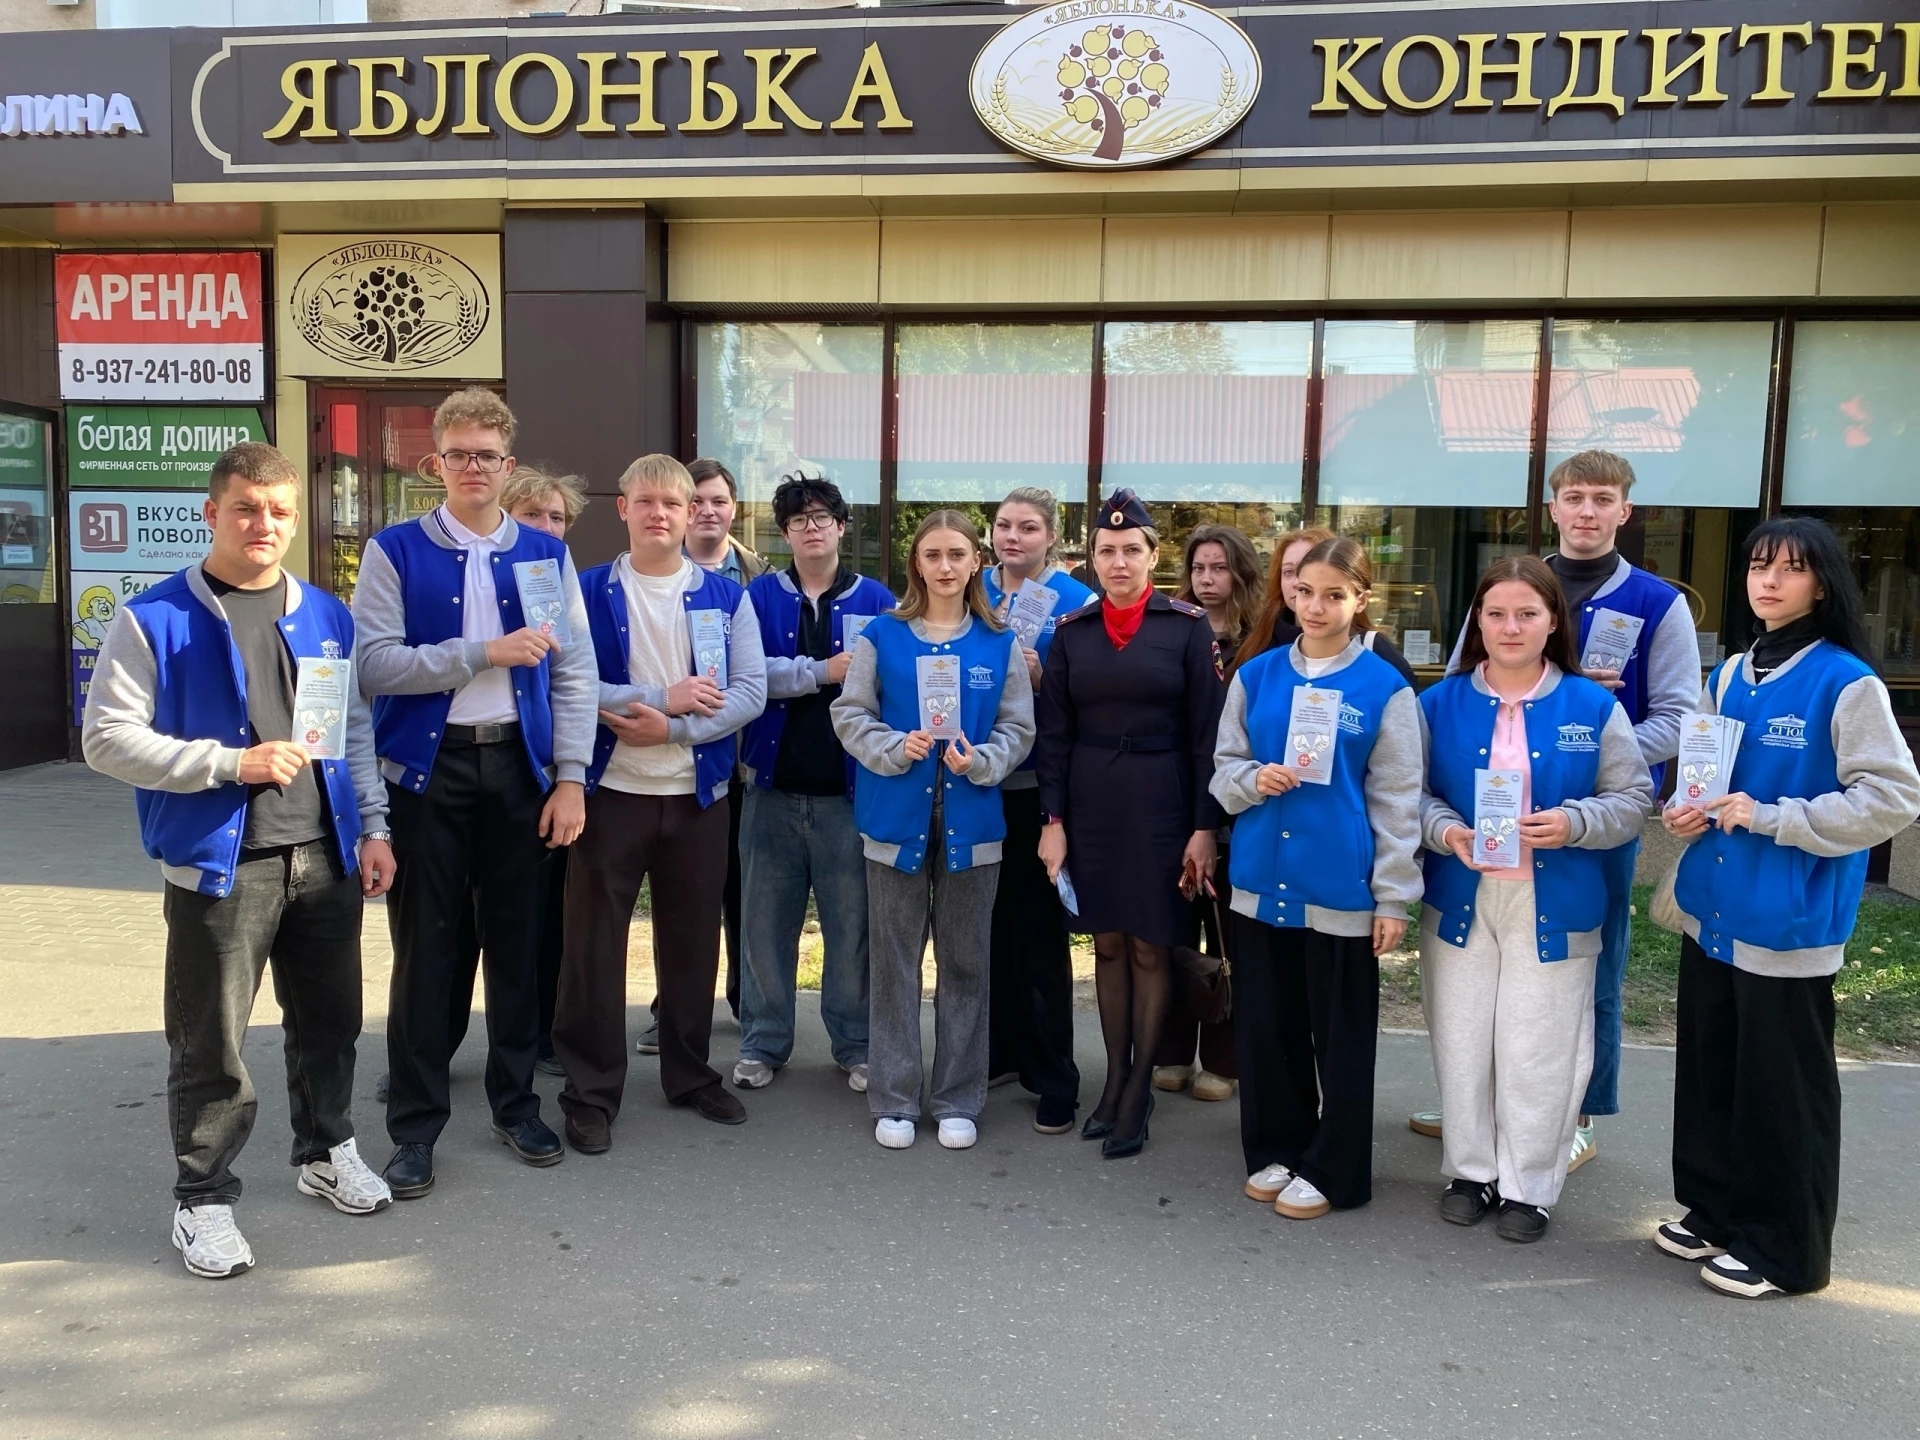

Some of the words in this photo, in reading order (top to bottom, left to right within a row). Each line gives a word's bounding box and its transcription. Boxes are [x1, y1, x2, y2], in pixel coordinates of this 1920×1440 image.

[263, 42, 914, 139] ЯБЛОНЬКА
[0, 93, 143, 136] ЛИНА
[70, 273, 248, 329] АРЕНДА
[72, 358, 252, 384] 8-937-241-80-08
[77, 415, 151, 452] белая
[79, 460, 134, 471] ФИРМЕННАЯ
[136, 461, 159, 471] СЕТЬ
[160, 461, 172, 471] ОТ
[139, 549, 183, 559] Сделано
[1559, 732, 1592, 742] СГЮА
